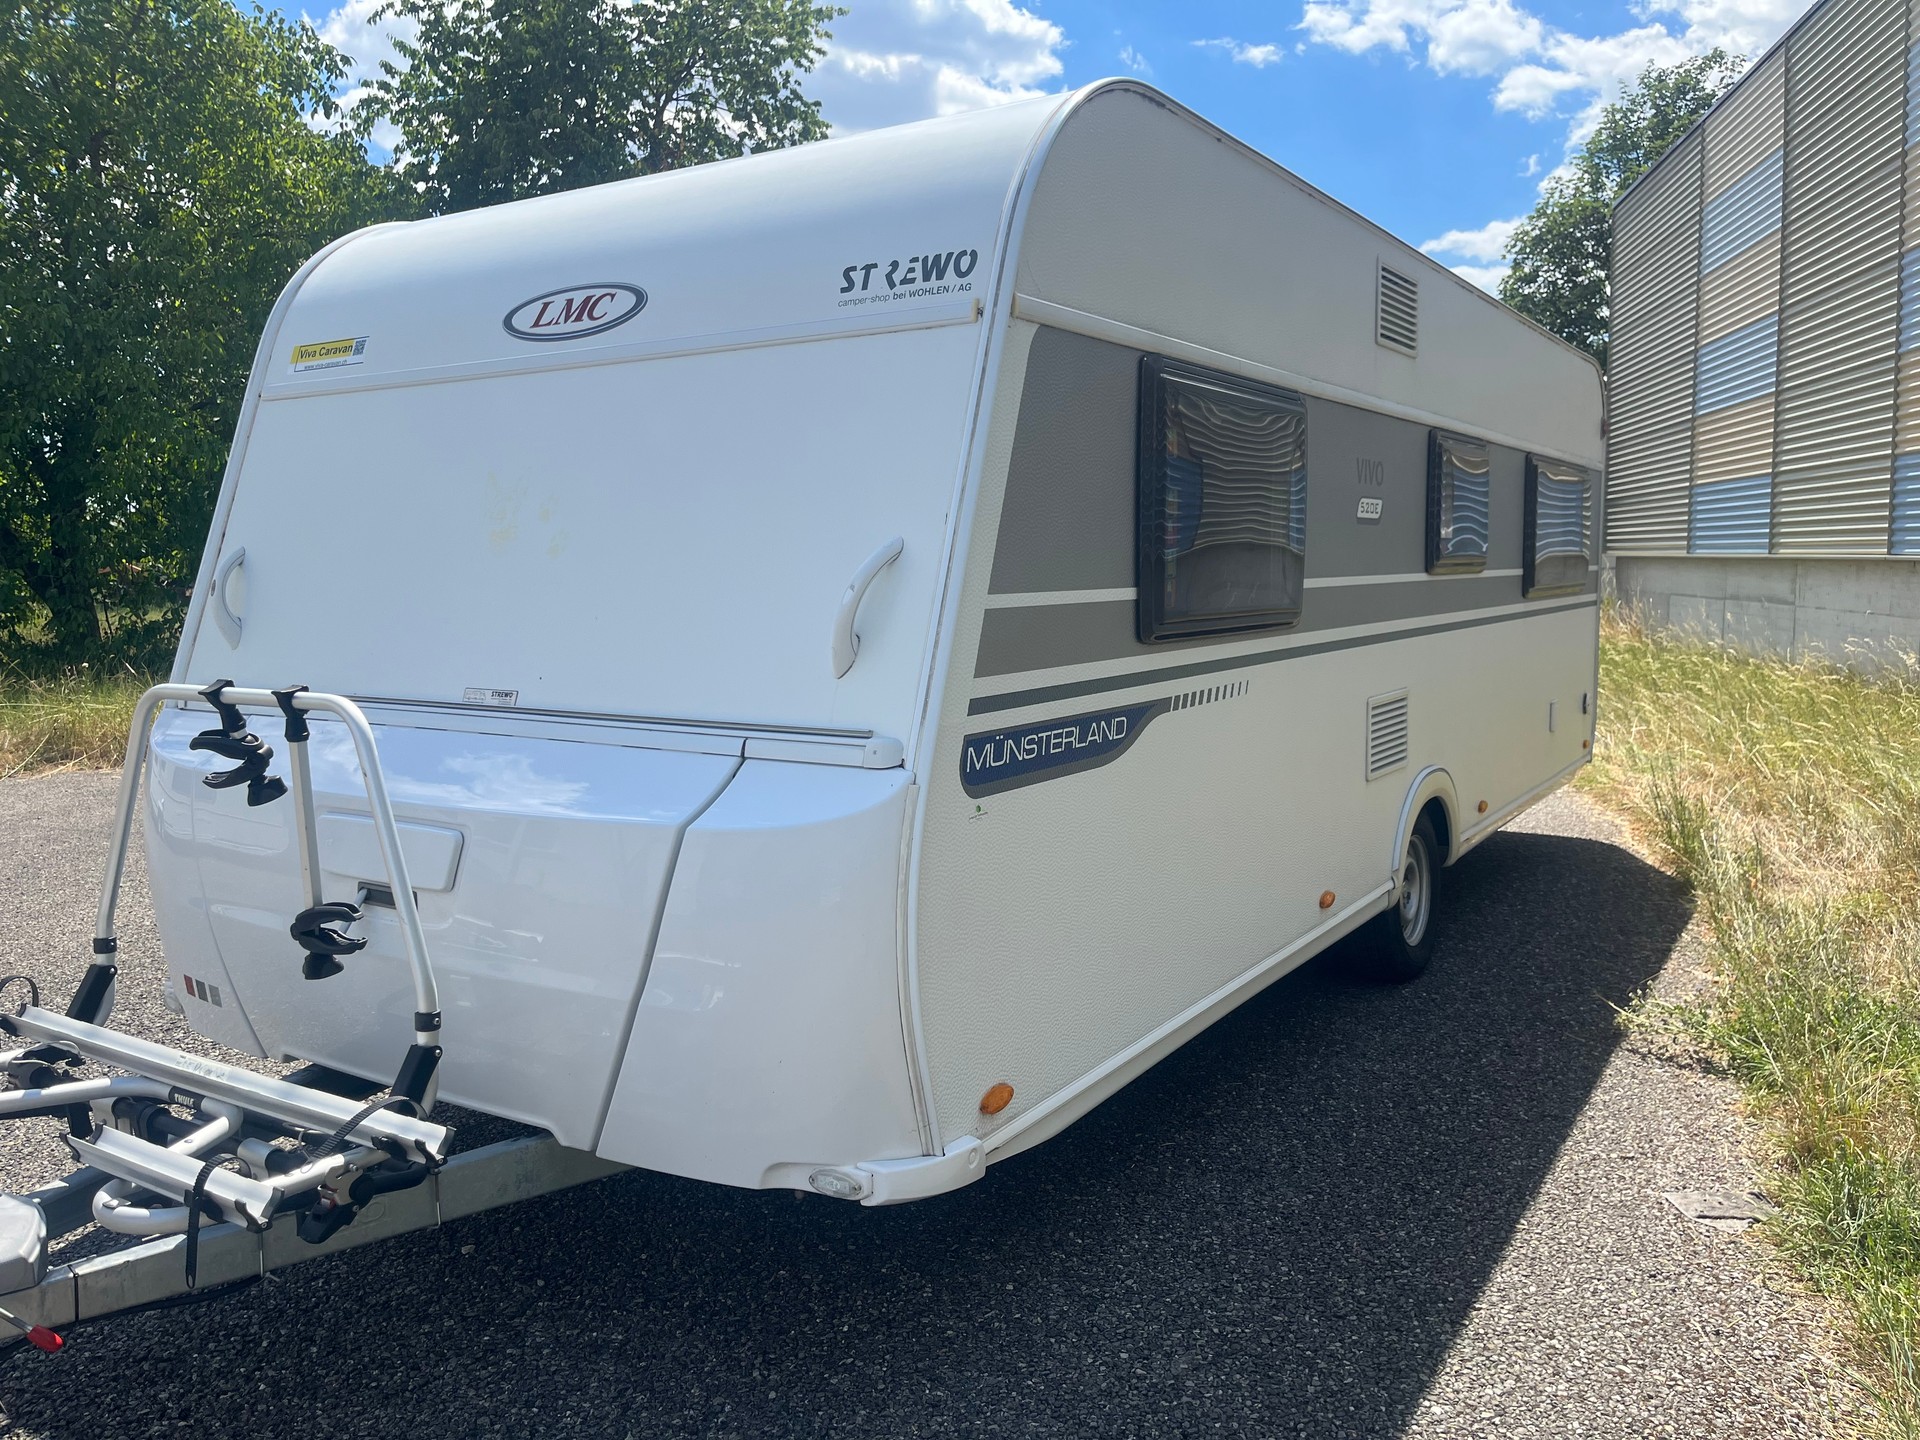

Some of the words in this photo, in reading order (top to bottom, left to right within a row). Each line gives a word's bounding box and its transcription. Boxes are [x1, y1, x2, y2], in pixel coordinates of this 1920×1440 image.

[840, 249, 978, 294] STREWO
[838, 293, 890, 308] camper-shop
[893, 290, 907, 300] bei
[909, 285, 950, 298] WOHLEN
[958, 283, 972, 292] AG
[529, 291, 617, 329] LMC
[300, 349, 317, 359] Viva
[318, 344, 353, 357] Caravan
[1356, 457, 1384, 487] VIVO
[1360, 502, 1379, 514] 520E
[966, 716, 1127, 773] MÜNSTERLAND
[174, 1093, 194, 1107] THULE
